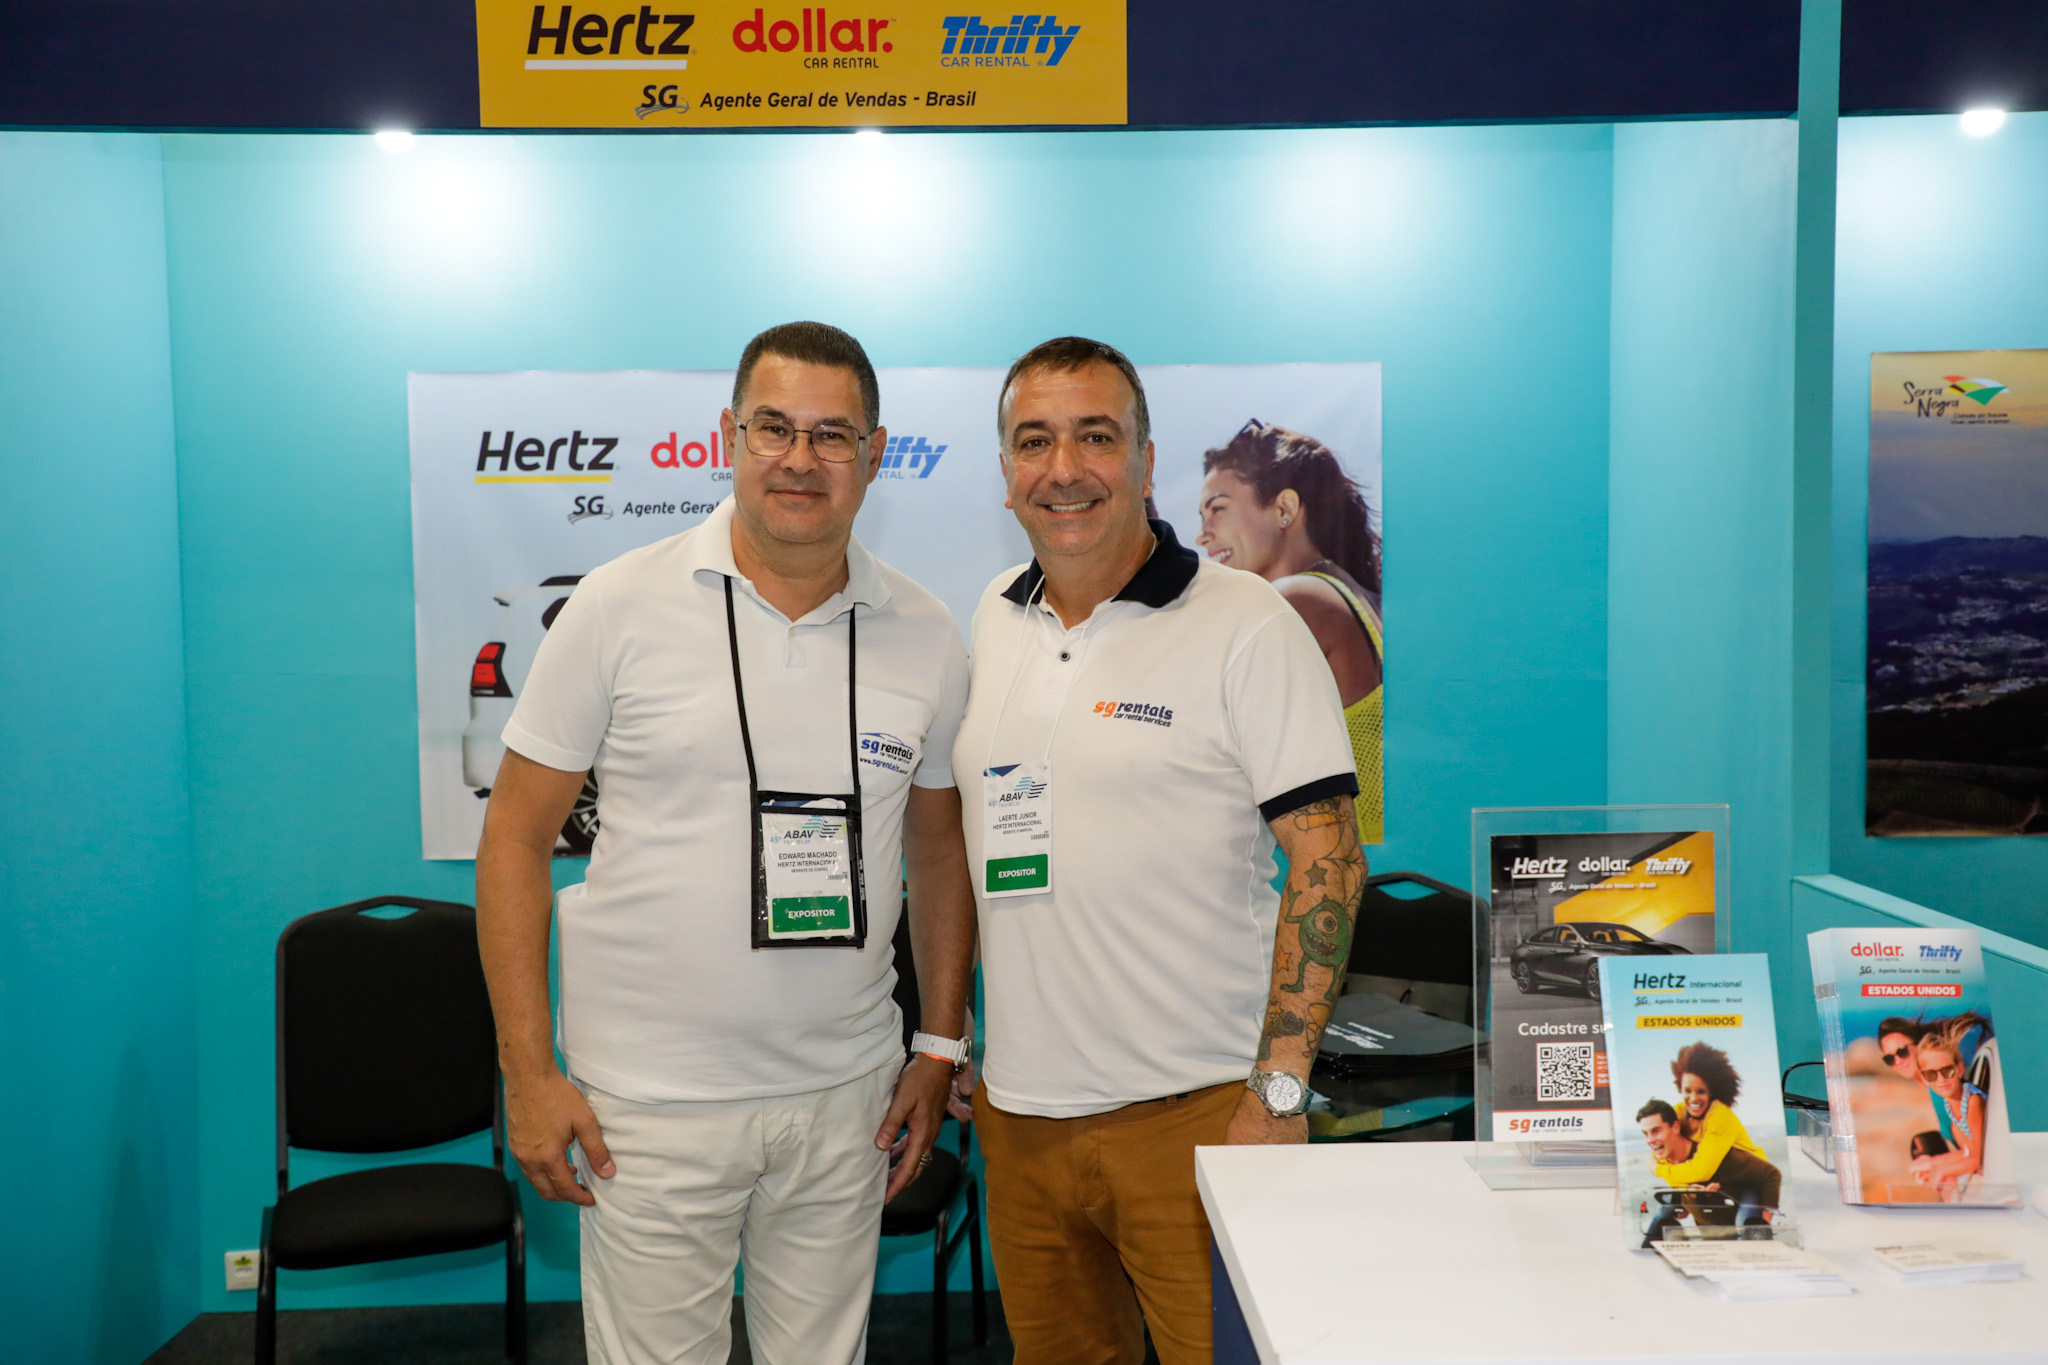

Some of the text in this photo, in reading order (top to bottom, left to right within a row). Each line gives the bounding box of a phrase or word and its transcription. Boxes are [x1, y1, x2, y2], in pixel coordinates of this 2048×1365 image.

[527, 5, 695, 55] Hertz
[732, 8, 893, 53] dollar.
[941, 15, 1082, 66] Thrifty
[803, 57, 879, 69] CAR RENTAL
[941, 57, 1030, 67] CAR RENTAL
[641, 85, 678, 108] SG
[700, 92, 762, 111] Agente
[767, 91, 812, 108] Geral
[818, 91, 838, 108] de
[845, 92, 907, 108] Vendas
[926, 91, 976, 107] Brasil
[1903, 380, 1943, 405] Serra
[1917, 397, 1959, 417] Negra
[476, 431, 619, 471] Hertz
[651, 432, 733, 468] dol
[881, 436, 948, 478] ifty
[711, 473, 733, 483] CAR
[573, 496, 604, 515] SG
[623, 501, 675, 517] Agente
[1093, 701, 1173, 720] sg rentals
[861, 739, 914, 760] sg rentals
[999, 791, 1024, 802] ABAV
[999, 811, 1037, 823] LAERTE JUNIOR
[993, 819, 1042, 831] HERTZ INTERNACIONAL
[783, 830, 814, 839] ABAV
[779, 851, 837, 860] EDWARD MACHADO
[1513, 856, 1569, 874] Hertz
[1578, 856, 1631, 872] dollar.
[1645, 857, 1692, 875] Thrifty
[998, 868, 1036, 878] EXPOSITOR
[1551, 882, 1564, 890] SG
[788, 909, 835, 919] EXPOSITOR
[1851, 942, 1904, 957] dollar.
[1919, 945, 1963, 962] Thrifty
[1860, 966, 1872, 974] SG
[1634, 973, 1742, 988] Hertz Internacional
[1868, 986, 1956, 995] ESTADOS UNIDOS
[1518, 1023, 1605, 1036] Cadastre su
[1643, 1017, 1736, 1027] ESTADOS UNIDOS
[1509, 1116, 1583, 1133] sg rentals
